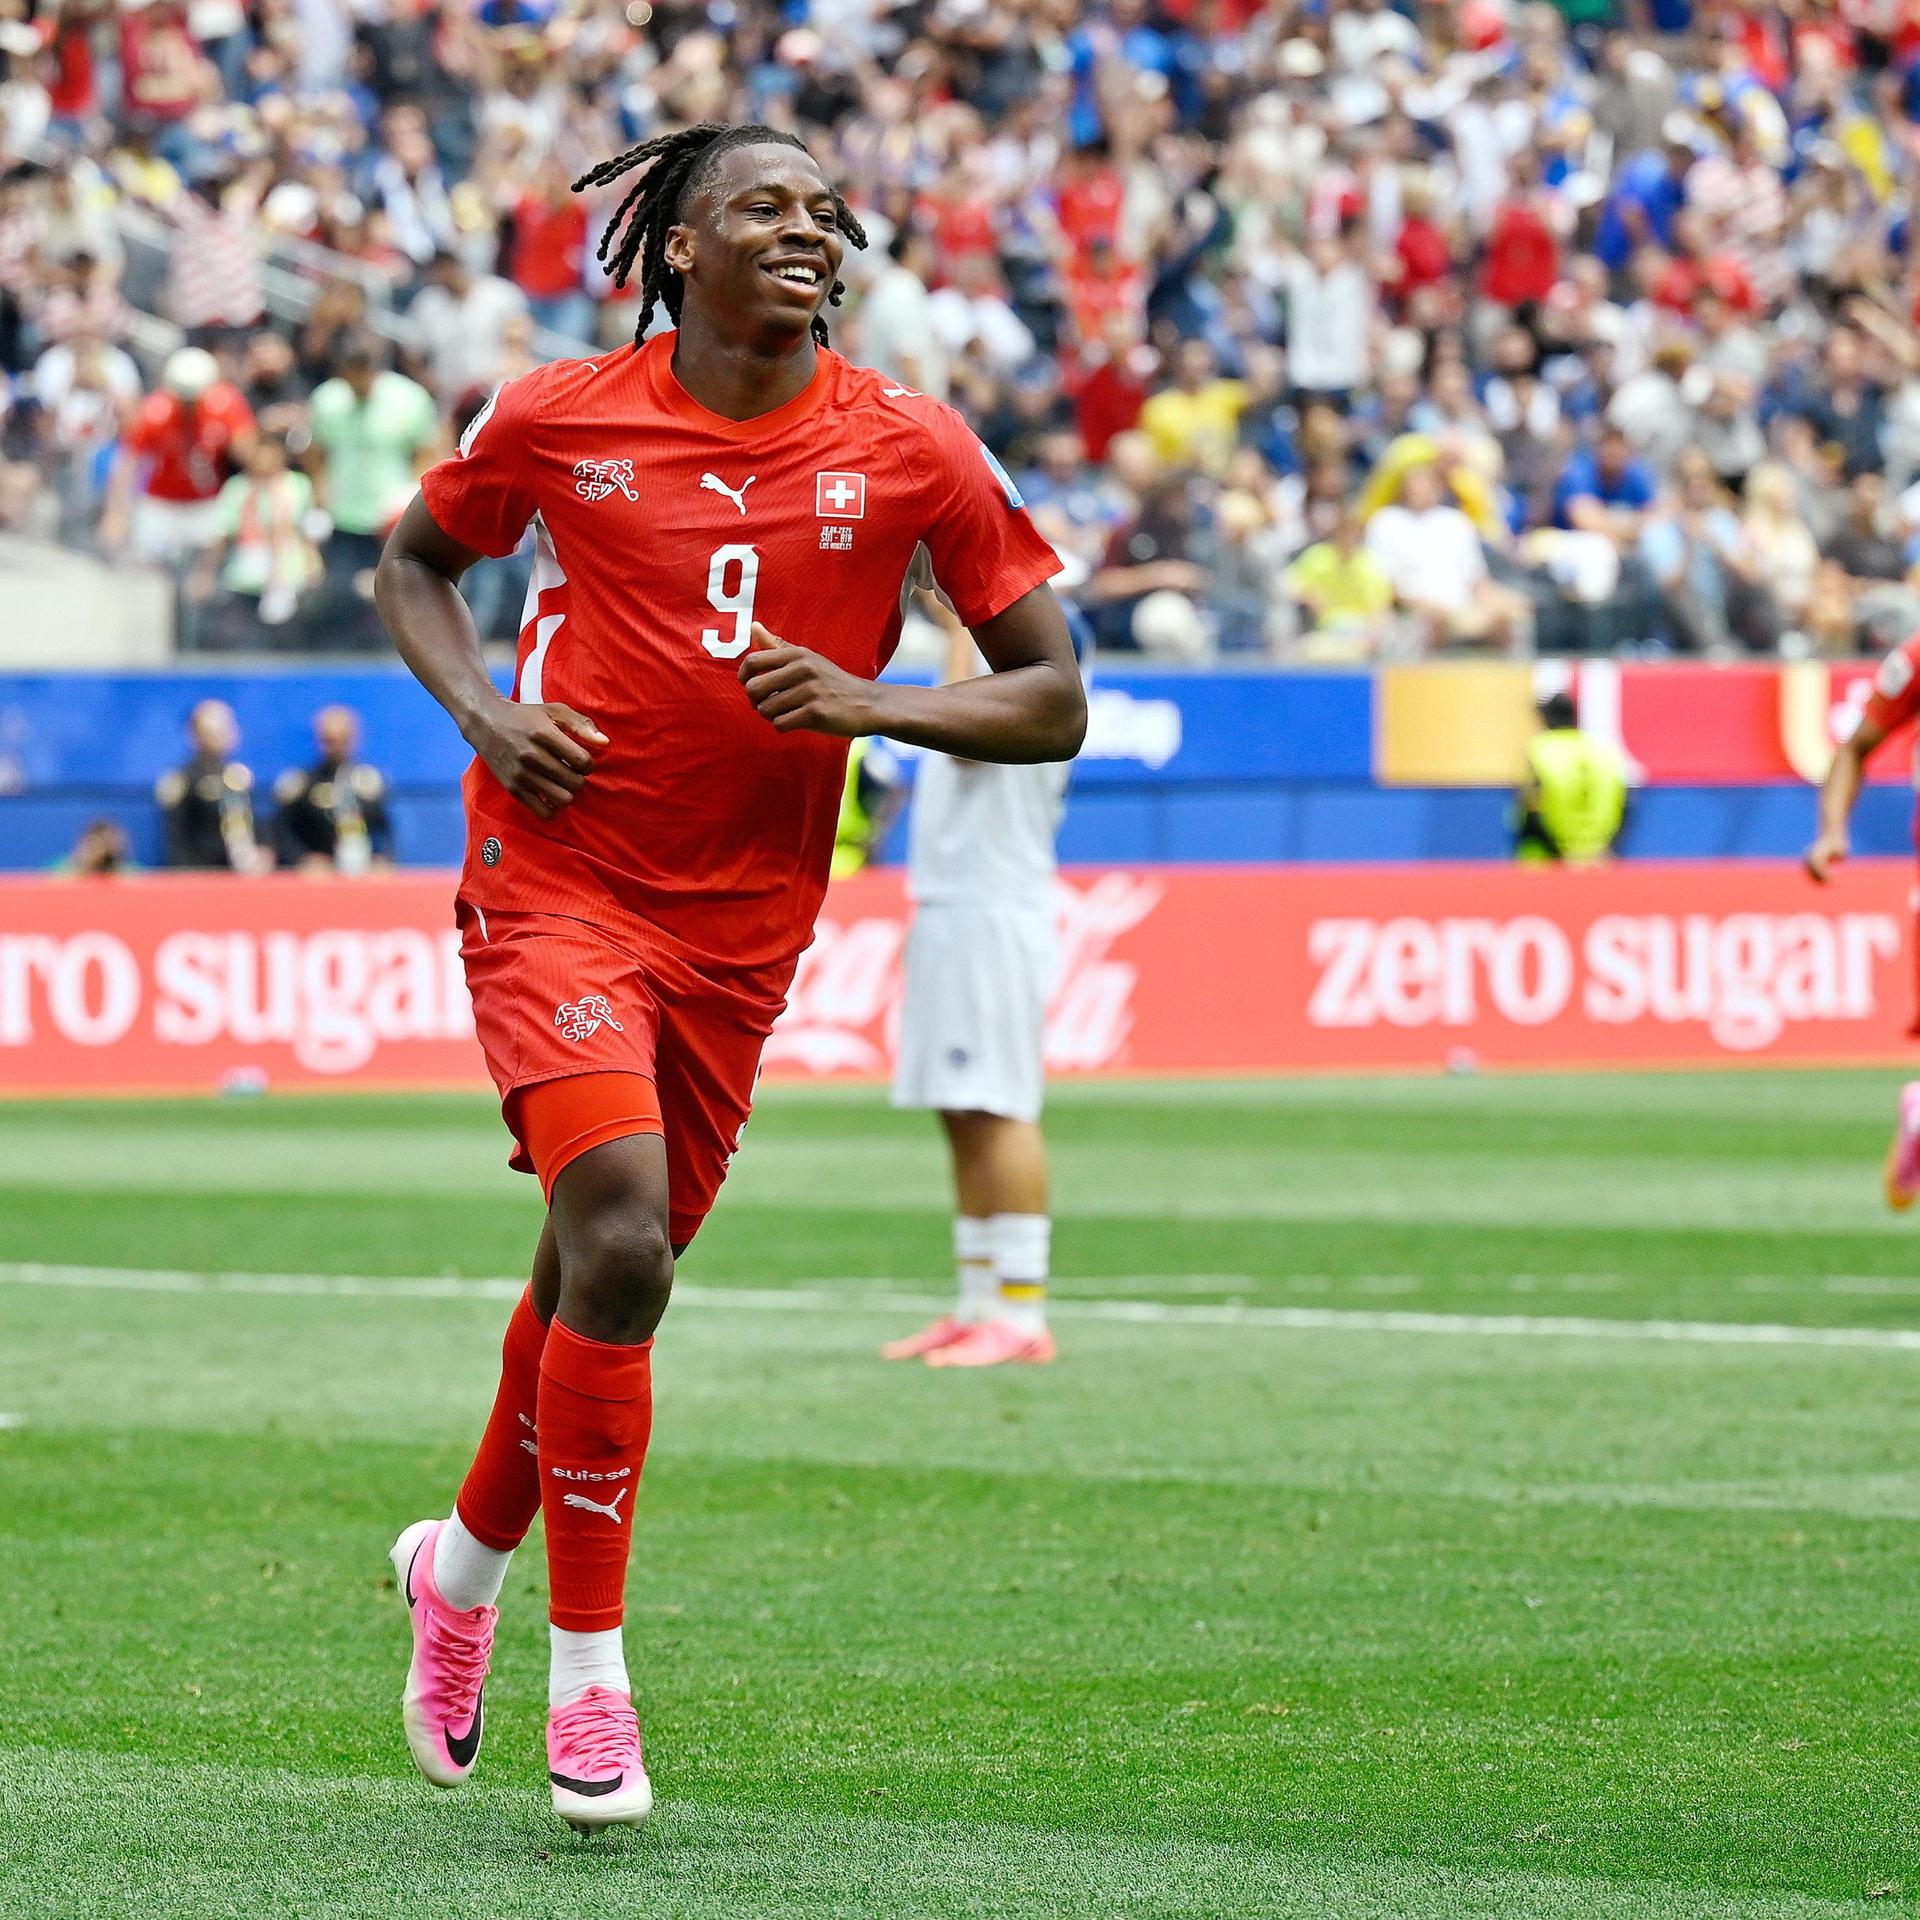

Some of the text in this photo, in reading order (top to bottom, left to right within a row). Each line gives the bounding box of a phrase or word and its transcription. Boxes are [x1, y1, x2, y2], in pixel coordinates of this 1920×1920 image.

[701, 544, 760, 659] 9
[1306, 915, 1574, 1027] zero
[1583, 912, 1899, 1051] sugar
[551, 1467, 631, 1482] suisse
